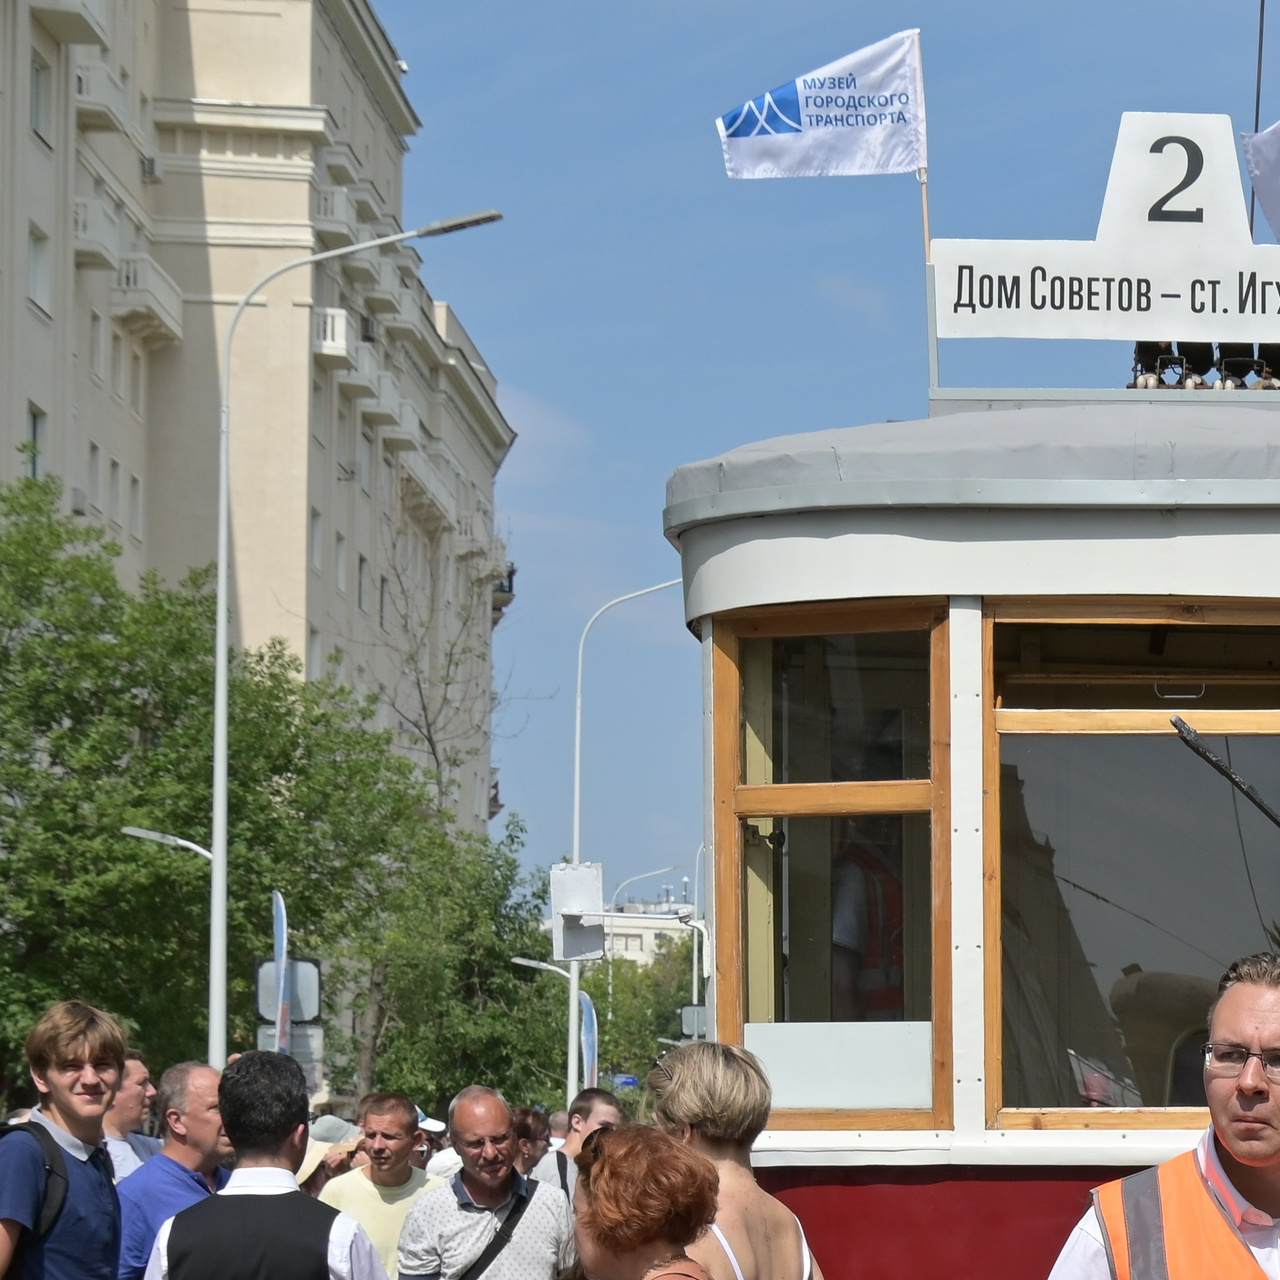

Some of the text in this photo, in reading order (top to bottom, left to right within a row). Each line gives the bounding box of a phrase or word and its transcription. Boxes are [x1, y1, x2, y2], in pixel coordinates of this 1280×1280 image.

[802, 73, 857, 90] МУЗЕЙ
[805, 92, 910, 111] ГОРОДСКОГО
[806, 111, 908, 127] ТРАНСПОРТА
[1147, 135, 1205, 223] 2
